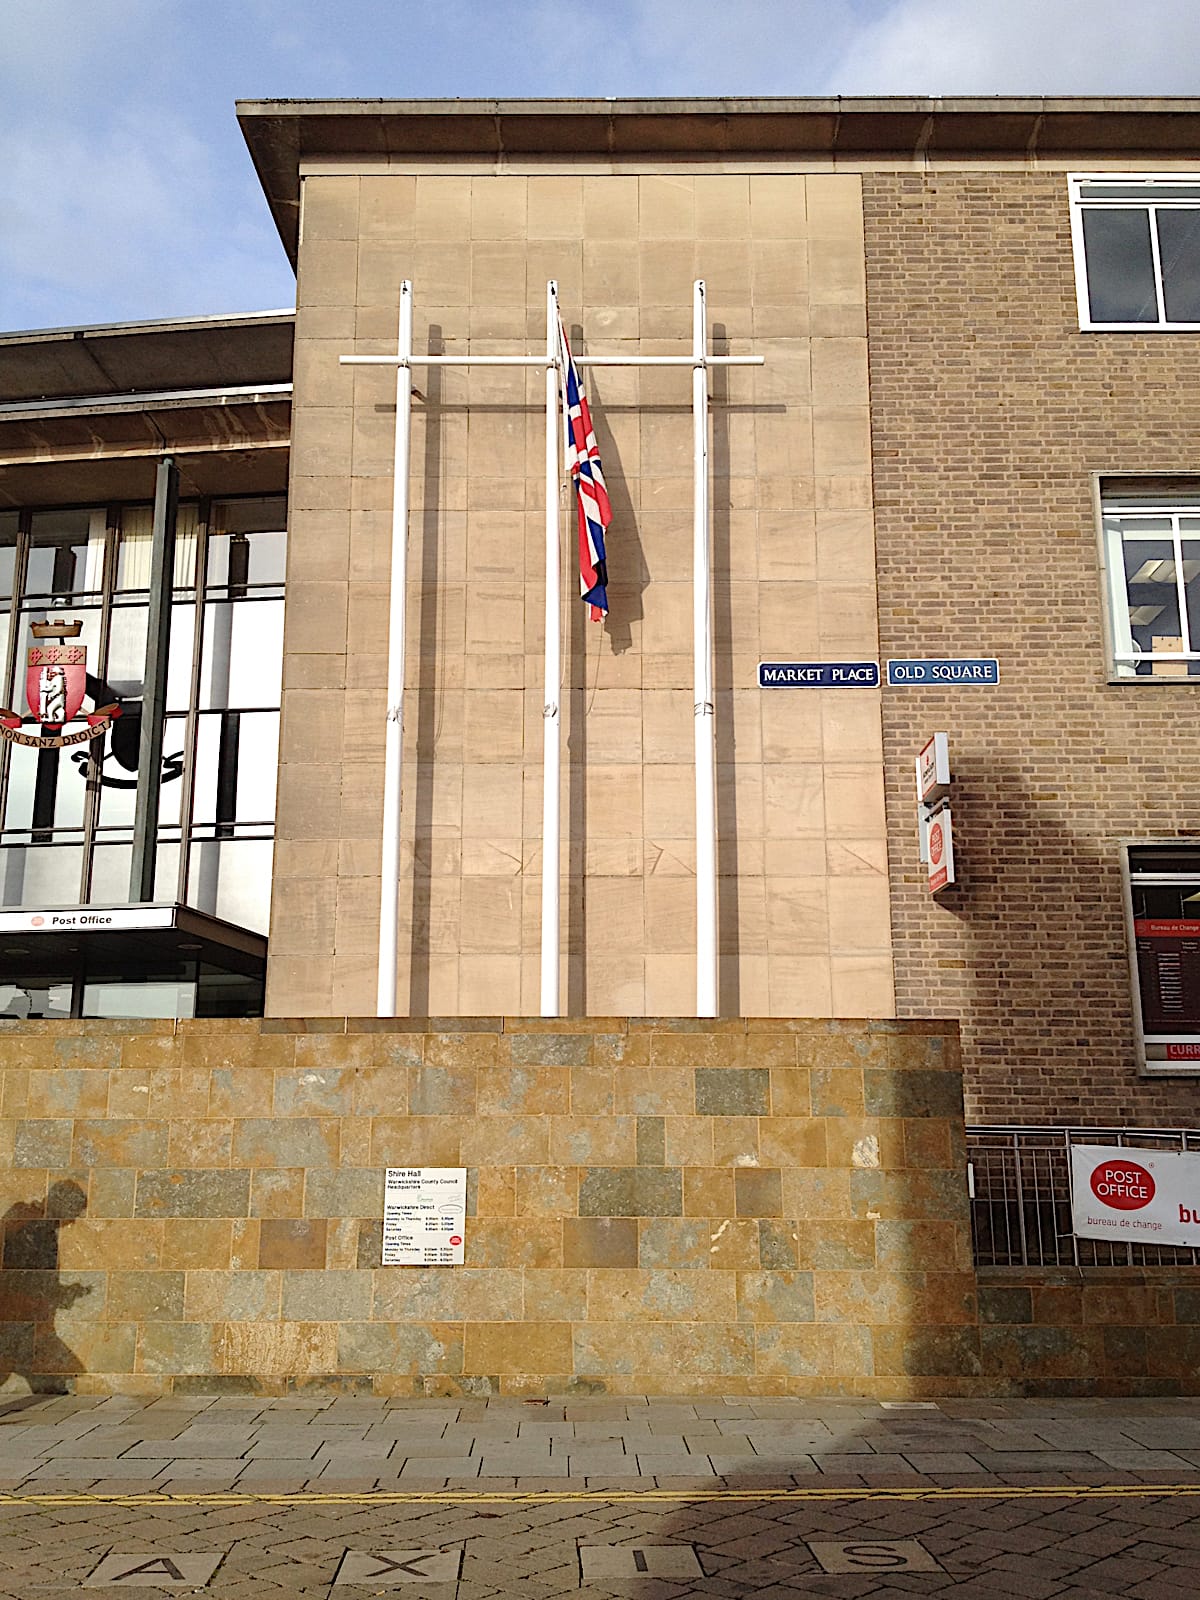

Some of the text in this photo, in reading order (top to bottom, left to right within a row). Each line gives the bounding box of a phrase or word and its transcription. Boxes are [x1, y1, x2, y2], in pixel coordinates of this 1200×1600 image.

[764, 668, 874, 681] MARKET PLACE
[894, 665, 993, 681] OLD SQUARE
[0, 721, 108, 747] NON SANZ DROICT
[52, 916, 76, 925] Post
[80, 915, 112, 924] Office
[1179, 924, 1200, 933] Change
[1105, 1169, 1142, 1185] POST
[1096, 1182, 1149, 1199] OFFICE
[1087, 1215, 1163, 1231] bureau de change
